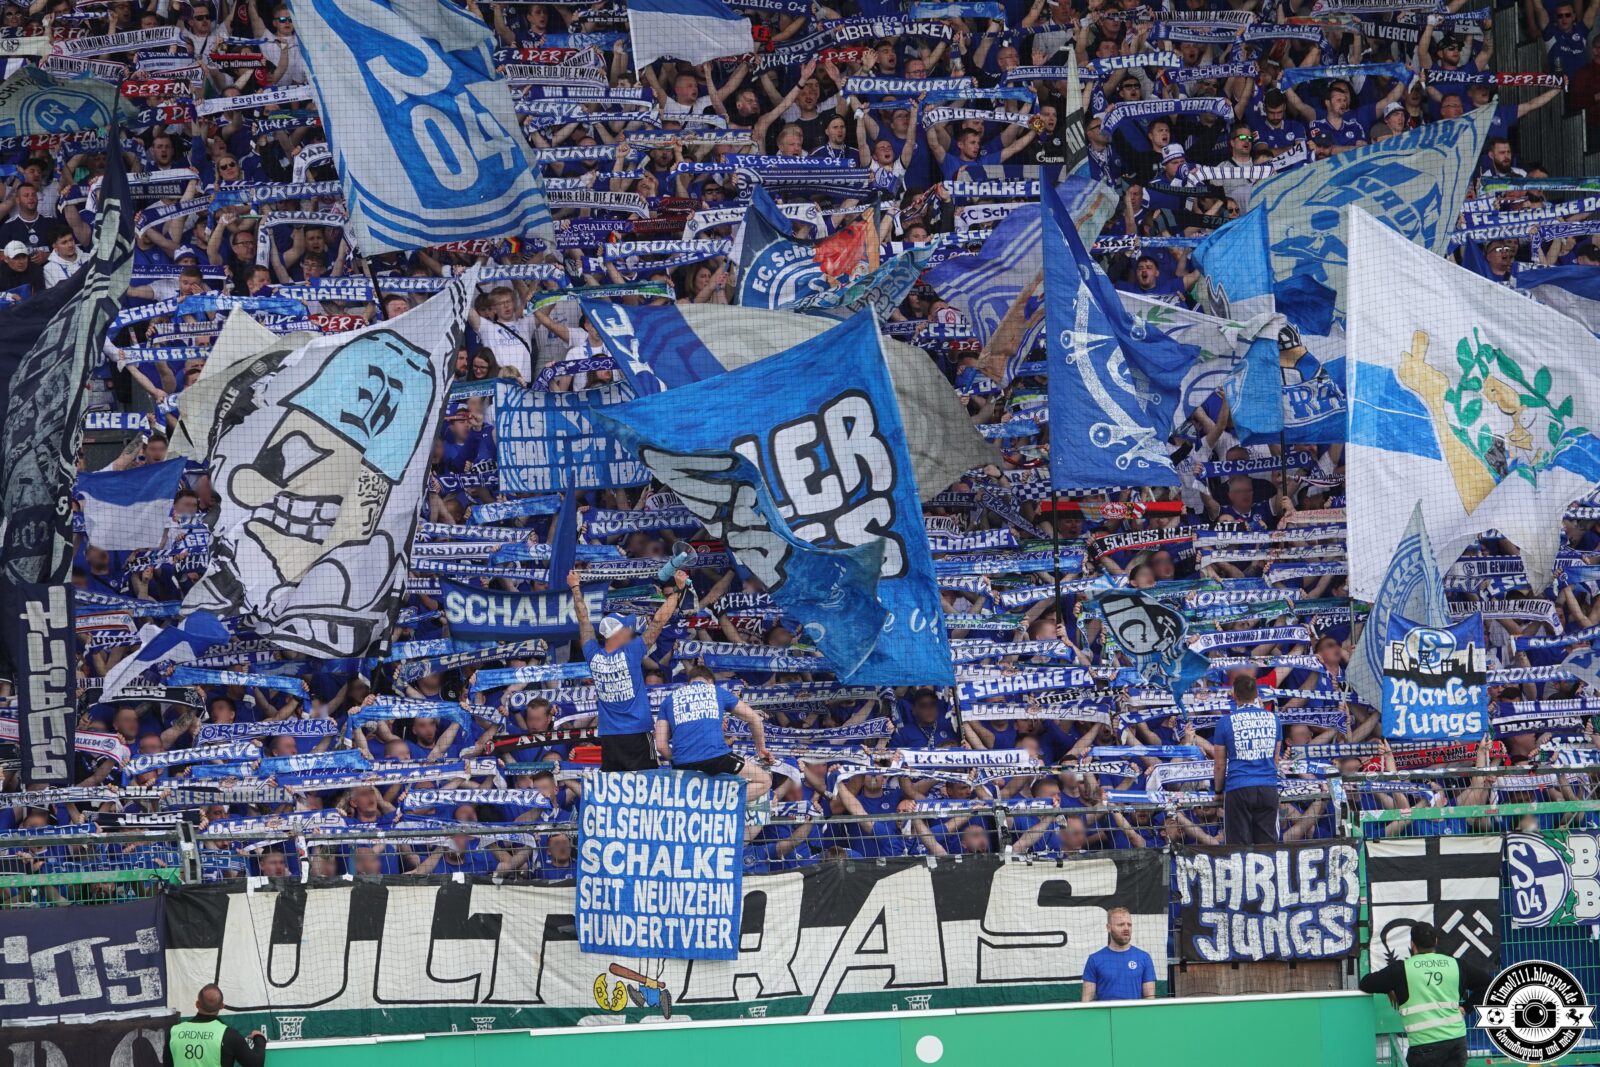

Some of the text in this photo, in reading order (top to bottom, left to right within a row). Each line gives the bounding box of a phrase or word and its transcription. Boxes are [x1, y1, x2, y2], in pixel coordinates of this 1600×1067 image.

[1378, 26, 1419, 43] VEREIN
[1100, 52, 1181, 70] SCHALKE
[1428, 72, 1483, 84] SCHALKE
[1537, 74, 1563, 85] FCN
[126, 82, 191, 96] DER FCN
[232, 91, 288, 106] Eagles 82
[1180, 98, 1216, 112] VEREIN
[736, 155, 757, 166] FC
[943, 180, 1026, 196] SCHALKE
[1472, 212, 1495, 226] FC
[1497, 200, 1581, 224] SCHALKE
[280, 288, 368, 301] SCHALKE
[1213, 460, 1233, 474] FC
[1103, 529, 1159, 551] SCHEISS
[1476, 561, 1489, 575] DU
[445, 590, 605, 628] SCHALKE
[592, 669, 631, 682] SCHALKE
[974, 668, 1095, 698] SCHALKE 04
[1390, 675, 1482, 706] Marler
[673, 693, 717, 706] SCHALKE
[1390, 705, 1483, 738] Jungs
[1233, 728, 1277, 739] SCHALKE
[128, 743, 259, 772] NORDKURVE
[946, 752, 1002, 765] Schalke
[405, 789, 552, 808] NORDKURVE
[583, 773, 739, 811] FUSSBALLCLUB
[582, 806, 737, 840] GELSENKIRCHEN
[581, 839, 735, 880] SCHALKE
[1175, 844, 1360, 914] MARLER
[580, 878, 734, 916] SEIT NEUNZEHN
[222, 857, 1119, 1015] ULTRAS
[579, 911, 734, 950] HUNDERTVIER
[1196, 905, 1356, 962] JUNGS
[1413, 958, 1451, 970] ORDNER
[1423, 971, 1444, 987] 79
[178, 1030, 215, 1041] ORDNER
[184, 1044, 204, 1060] 80
